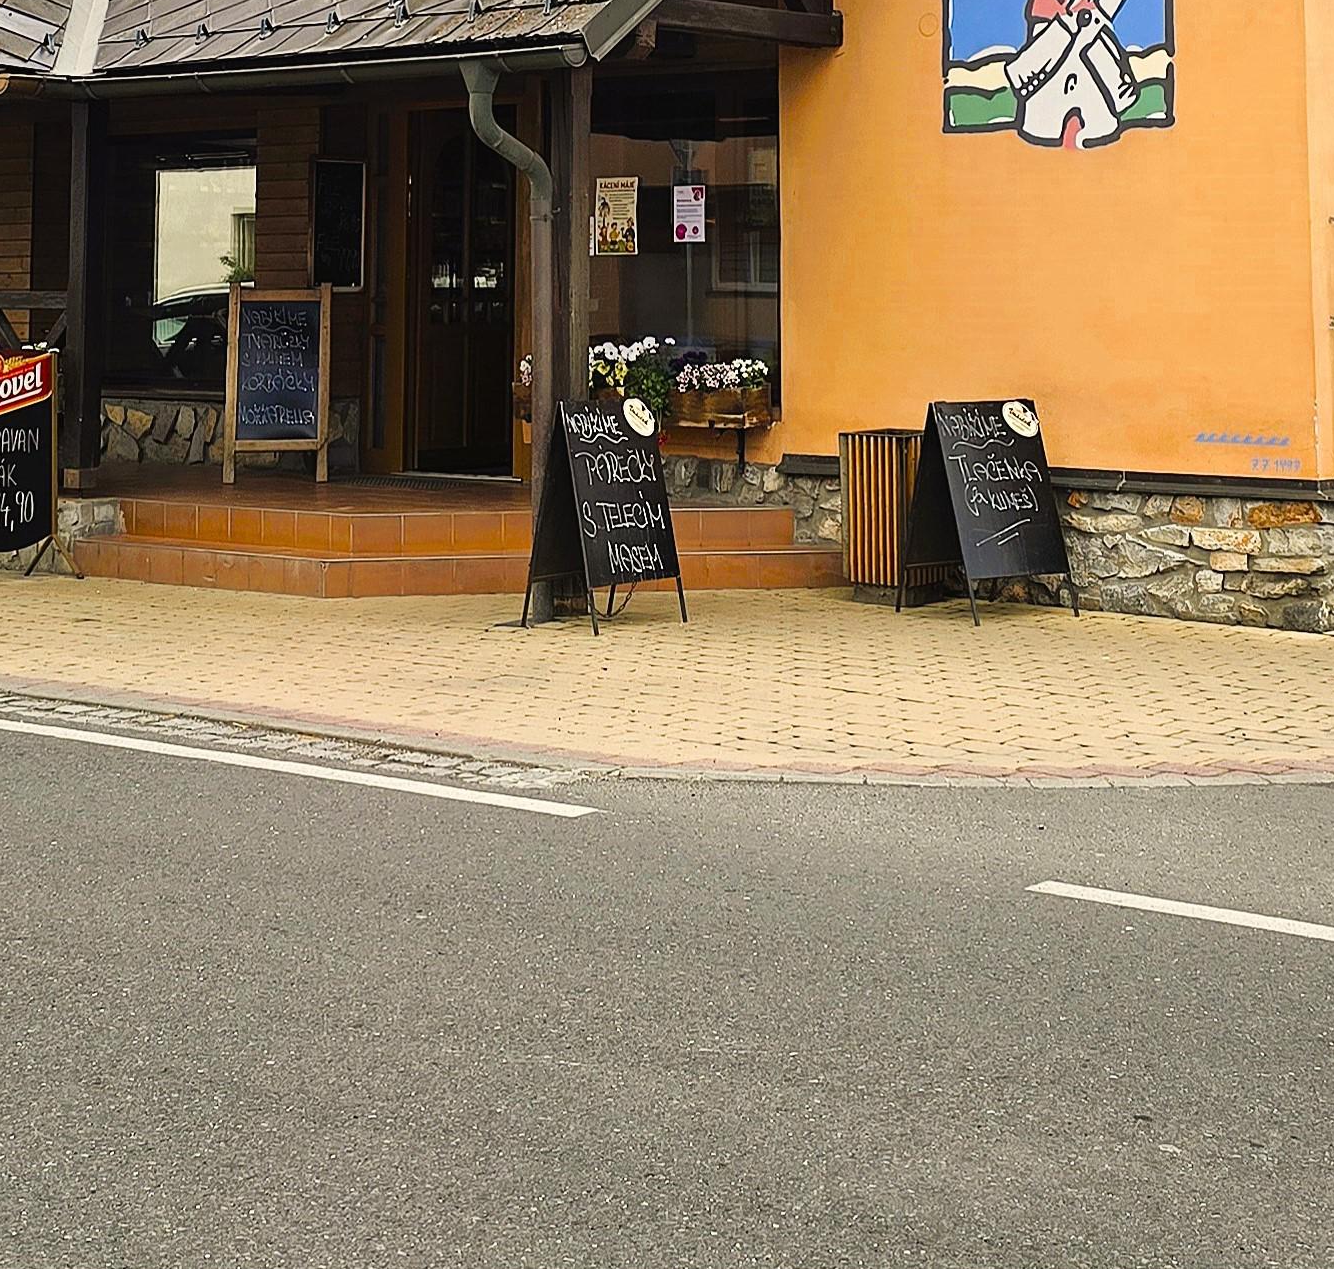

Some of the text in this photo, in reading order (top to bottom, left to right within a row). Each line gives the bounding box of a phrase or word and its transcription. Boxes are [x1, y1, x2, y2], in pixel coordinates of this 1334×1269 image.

[575, 445, 657, 486] PÁREČKY
[948, 453, 1043, 484] TLAČENKA
[582, 491, 666, 538] S TELECÍM
[607, 540, 664, 574] MASEM
